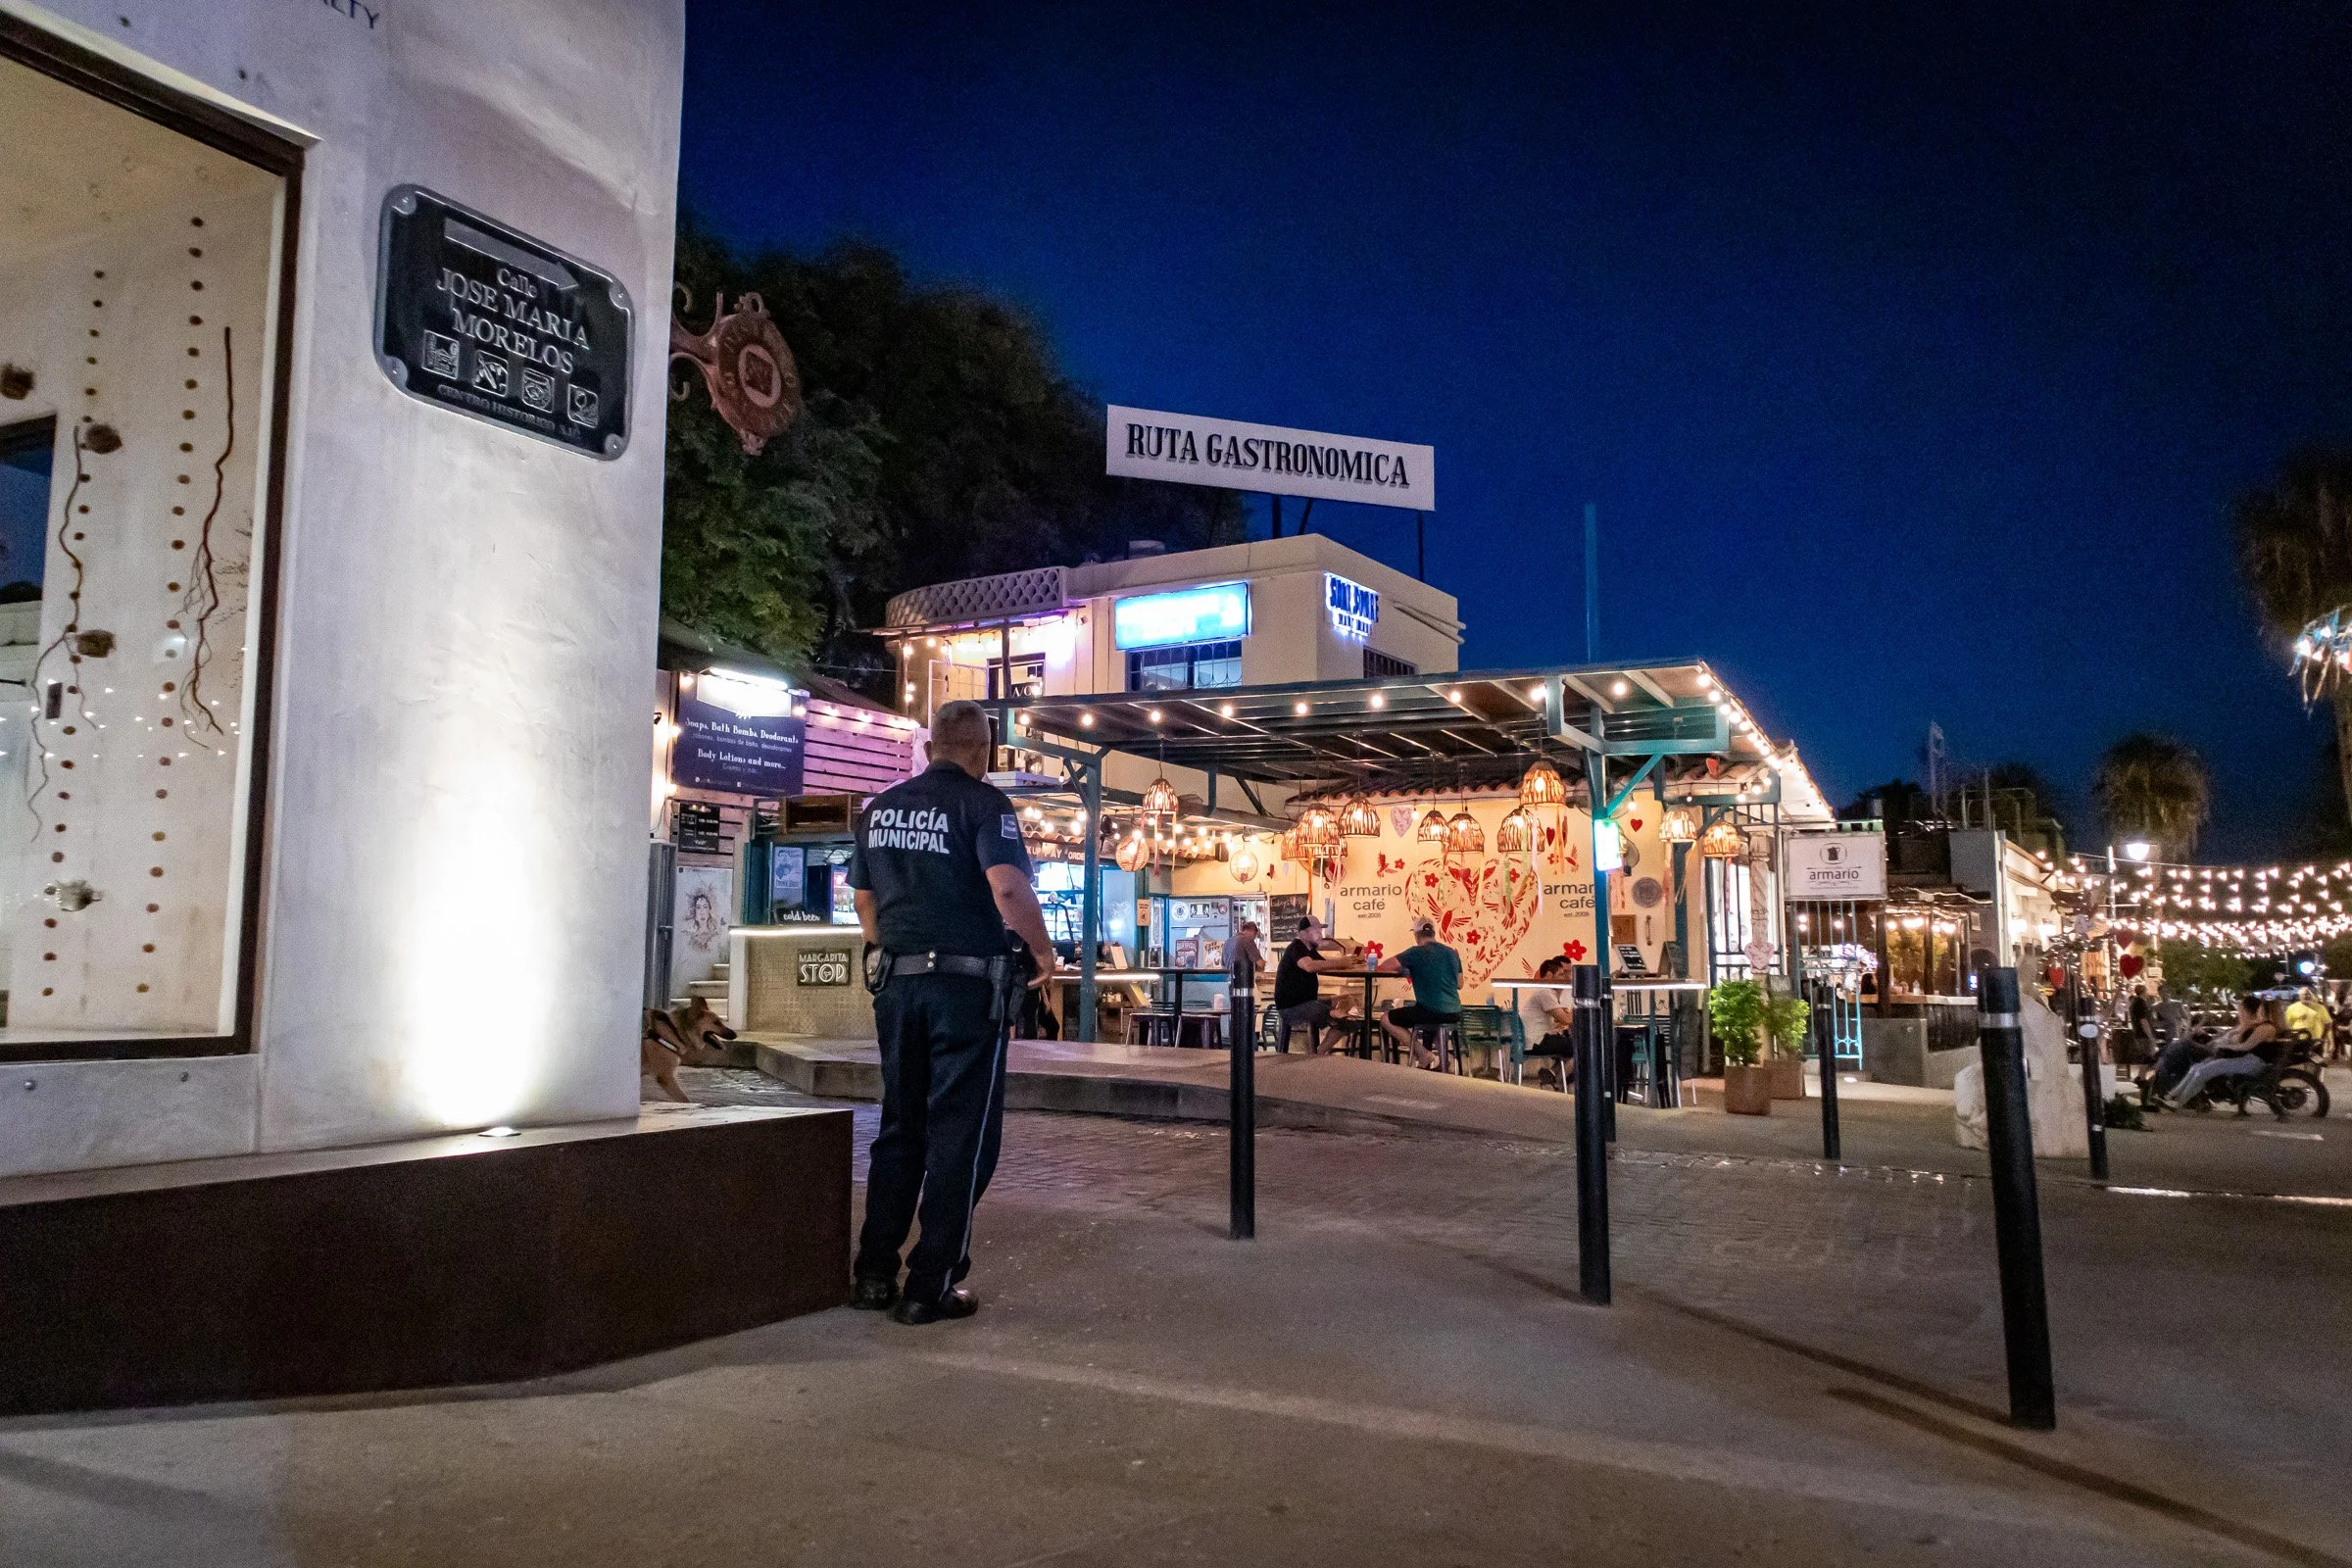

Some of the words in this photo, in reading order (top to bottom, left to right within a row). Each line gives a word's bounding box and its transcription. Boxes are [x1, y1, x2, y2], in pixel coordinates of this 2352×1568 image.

[498, 269, 537, 298] Calle
[436, 268, 499, 313] JOSE
[503, 294, 589, 350] MARIA
[452, 307, 573, 374] MORELOS
[1125, 422, 1200, 464] RUTA
[1205, 433, 1411, 487] GASTRONOMICA
[711, 721, 730, 734] Bath
[760, 729, 799, 744] Deodorants
[698, 749, 716, 762] Body
[719, 751, 746, 763] Lotions
[748, 757, 761, 765] and
[869, 808, 949, 833] POLICÍA
[868, 829, 950, 855] MUNICIPAL
[1809, 869, 1859, 880] armario
[1340, 884, 1402, 897] armario
[1352, 899, 1385, 911] café
[1559, 896, 1594, 908] café
[783, 910, 802, 921] cold
[799, 953, 848, 963] MARGARITA
[800, 963, 847, 983] STOP
